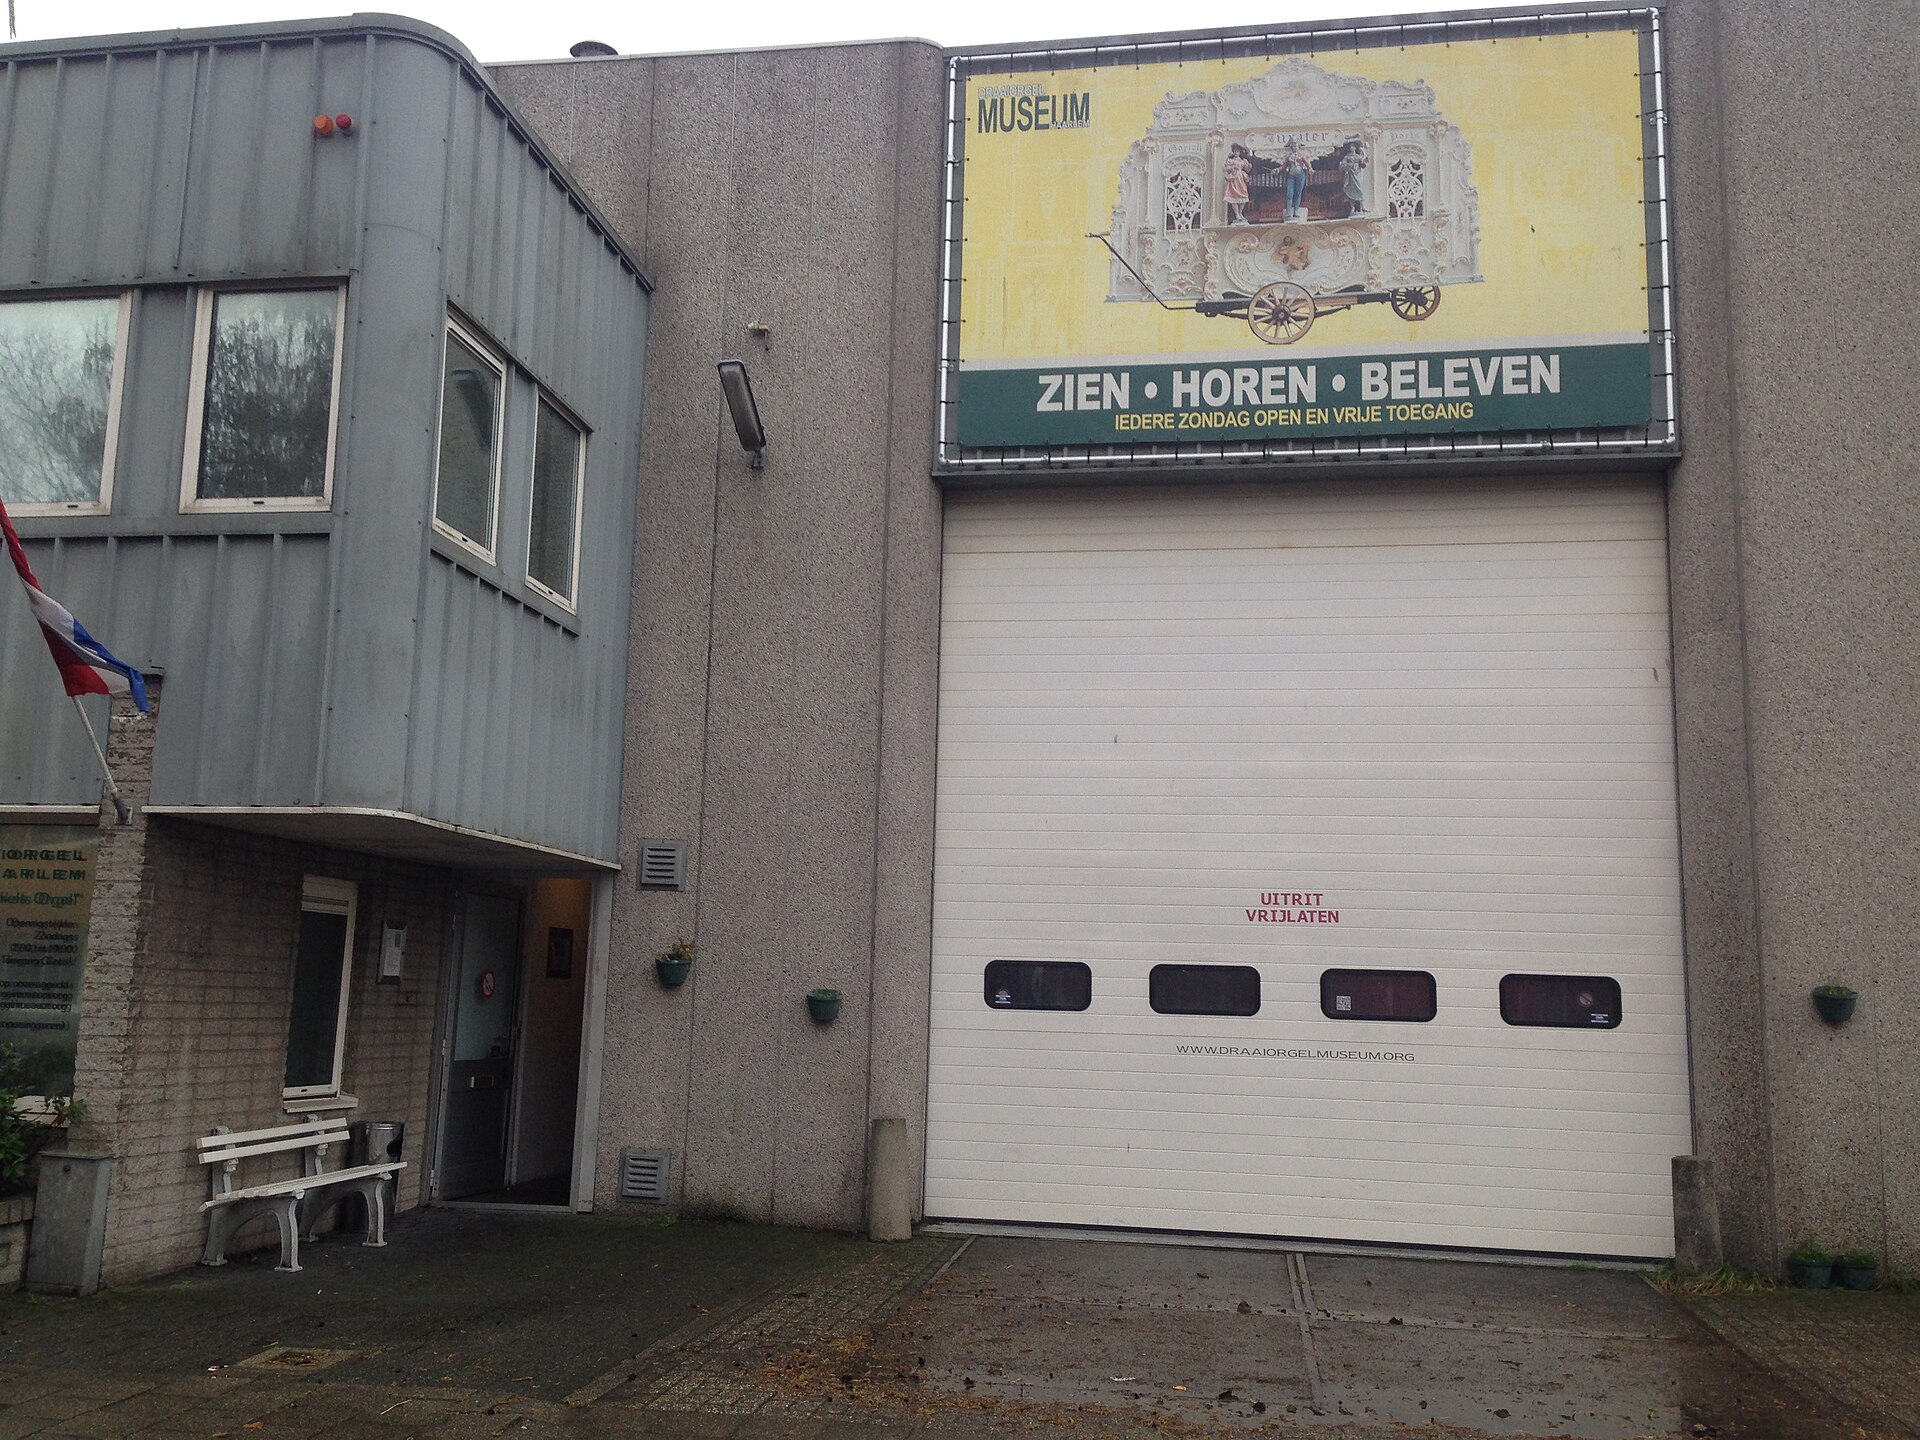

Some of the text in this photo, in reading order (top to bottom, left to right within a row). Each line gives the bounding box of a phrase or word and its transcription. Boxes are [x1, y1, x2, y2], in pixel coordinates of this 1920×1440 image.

[978, 83, 1046, 99] DRAAIORGEL
[978, 92, 1090, 133] MUSEUM
[1049, 119, 1090, 129] HAARLEM
[1036, 354, 1561, 412] ZIEN HOREN BELEVEN
[1115, 402, 1474, 430] IEDERE ZONDAG OPEN EN VRIJE TOEGANG
[1261, 893, 1323, 906] UITRIT
[1245, 909, 1339, 923] VRIJLATEN
[1176, 1045, 1415, 1062] WWW.DRAAIORGELMUSEUM.ORG
